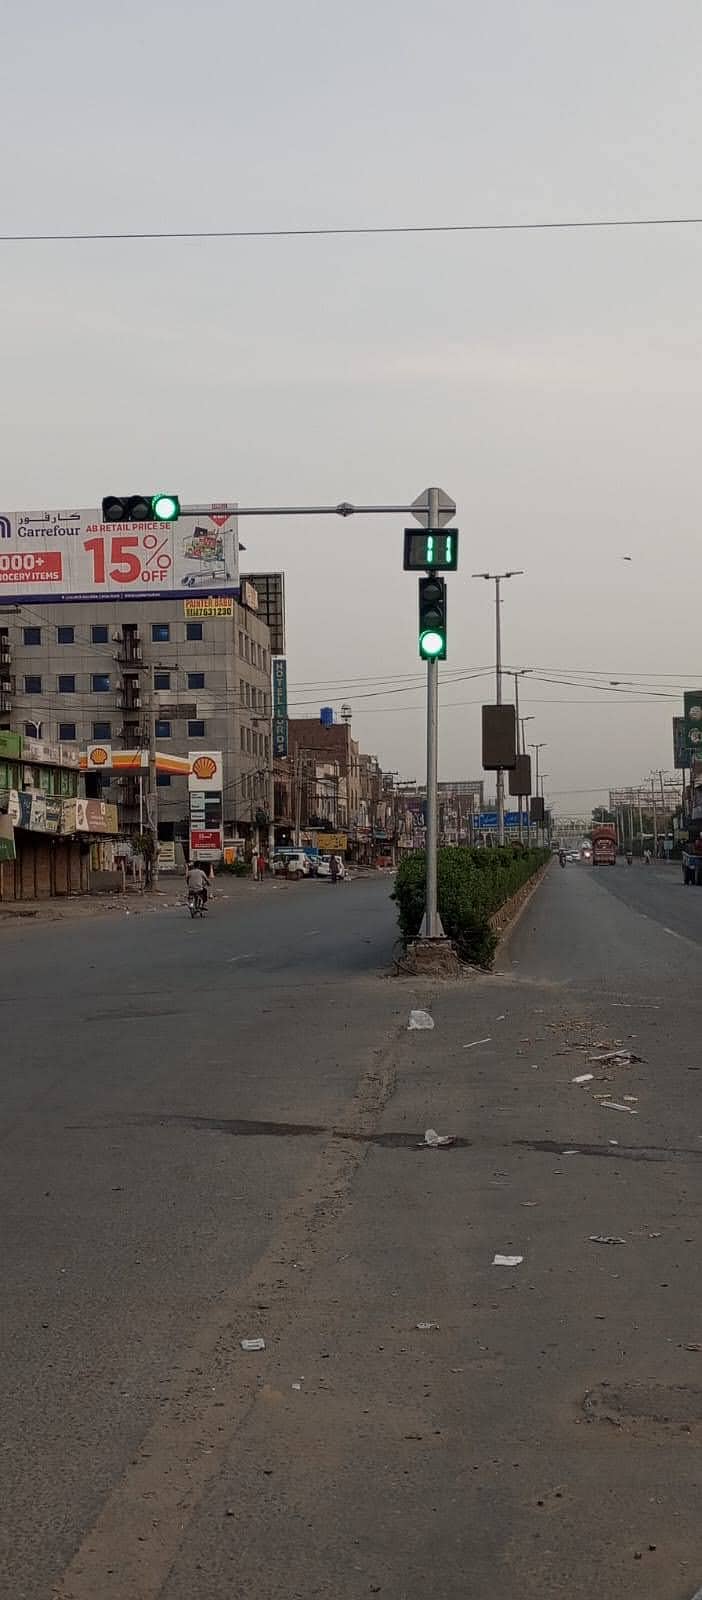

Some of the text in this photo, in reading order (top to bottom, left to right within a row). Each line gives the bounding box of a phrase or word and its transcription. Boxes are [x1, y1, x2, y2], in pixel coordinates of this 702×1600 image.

[18, 512, 80, 525] كارفور
[18, 525, 80, 537] Carrefour
[100, 524, 130, 532] RETAIL
[132, 522, 158, 531] PRICE
[159, 522, 171, 530] SE
[427, 535, 452, 563] 11
[83, 535, 172, 583] 15%
[32, 571, 59, 580] ITEMS
[141, 570, 168, 582] OFF
